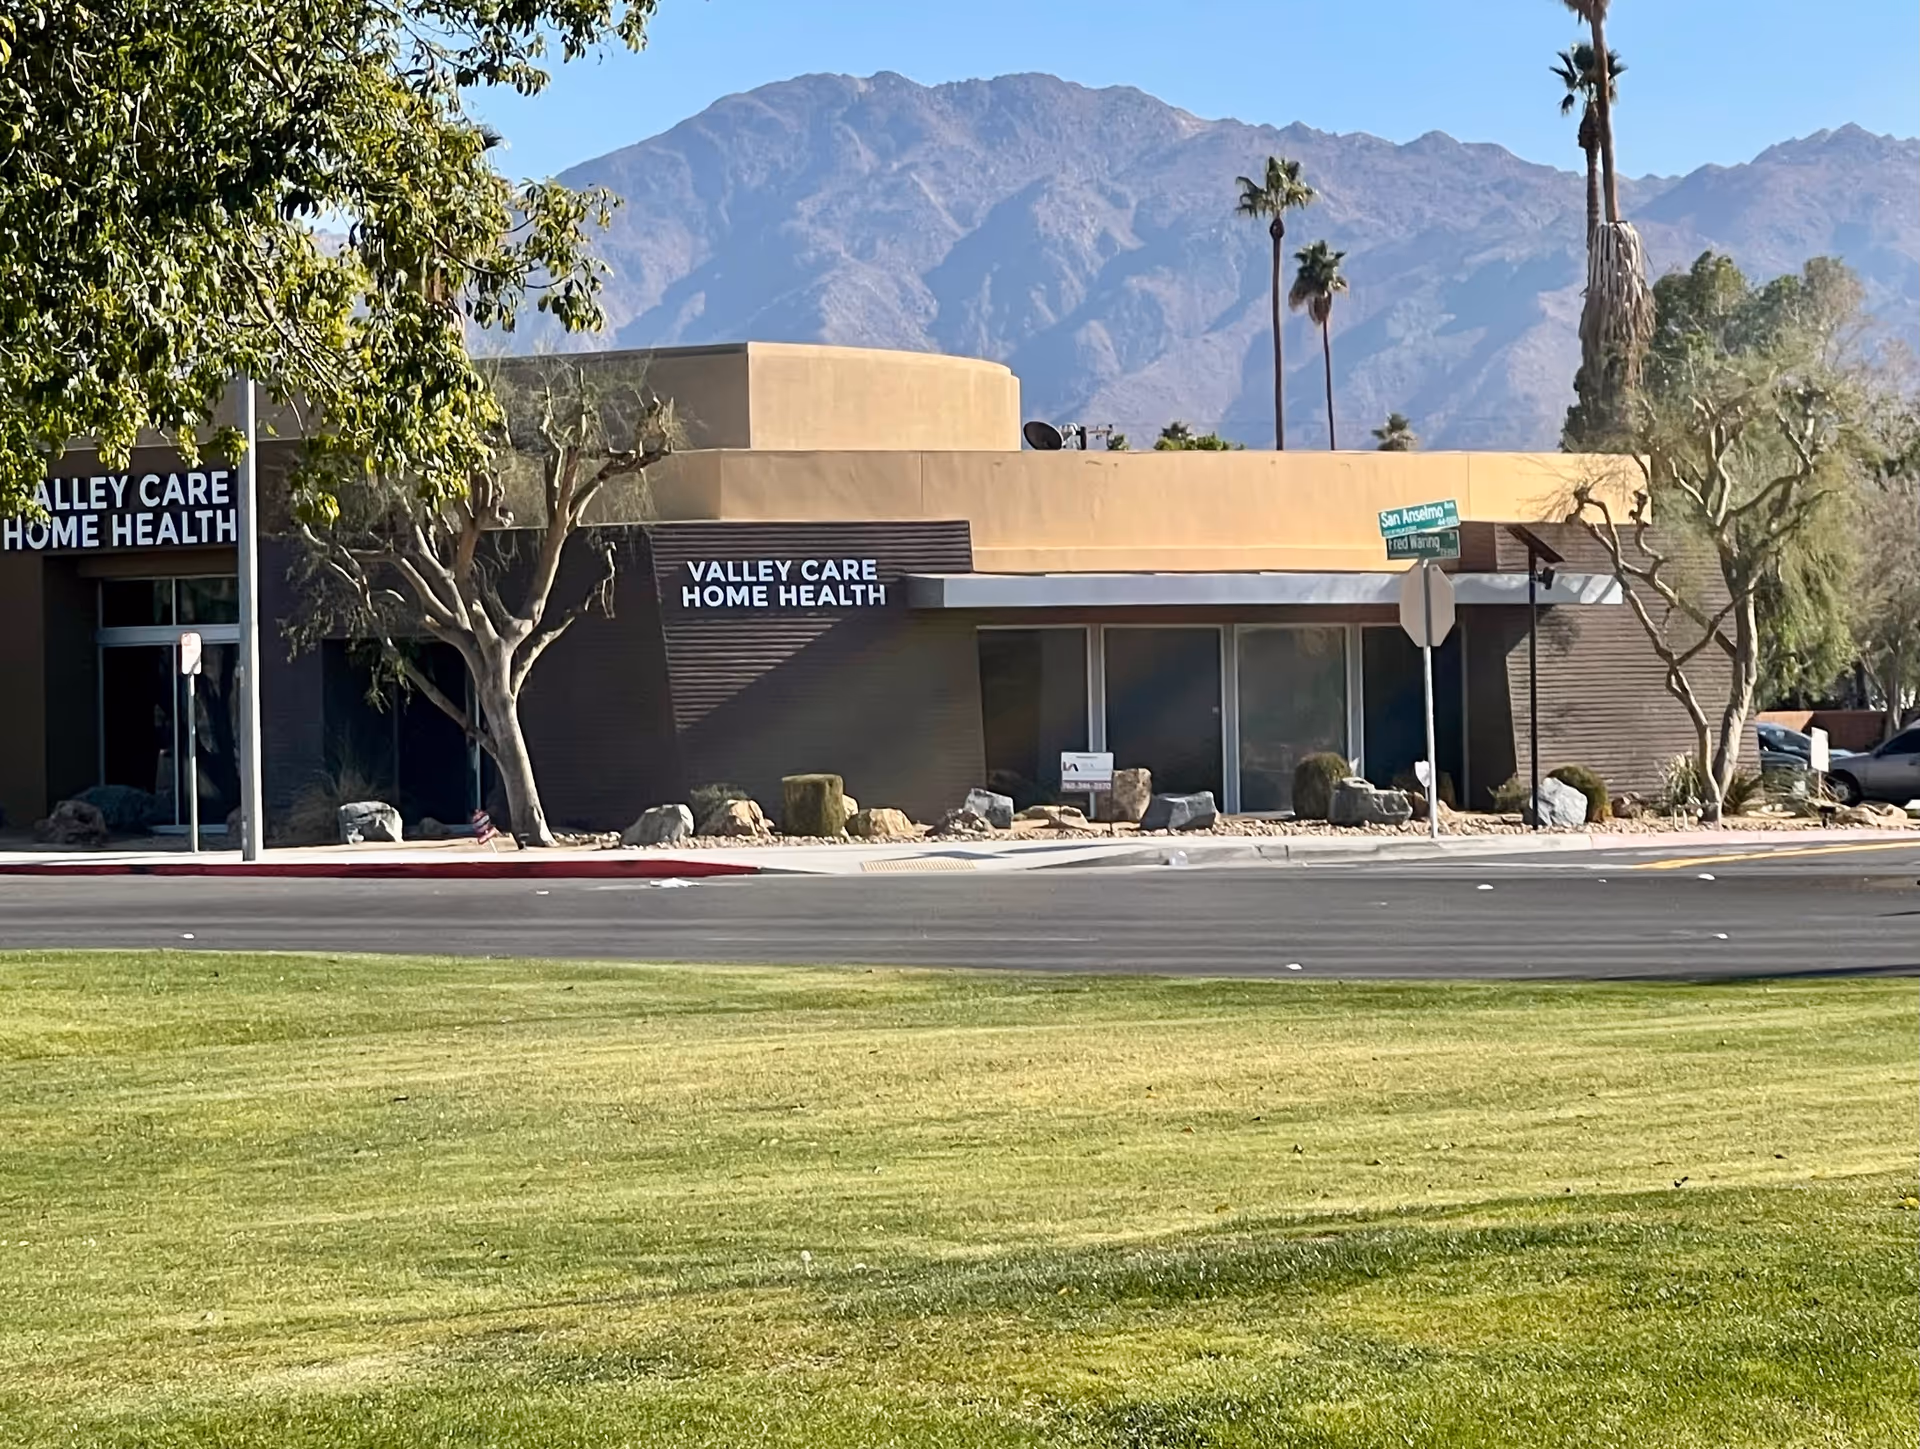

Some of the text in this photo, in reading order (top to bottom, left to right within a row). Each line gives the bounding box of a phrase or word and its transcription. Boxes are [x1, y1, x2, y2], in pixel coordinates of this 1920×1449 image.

[21, 471, 229, 511] ALLEY CARE
[1381, 512, 1401, 528] San
[1402, 505, 1443, 524] Anselmo
[4, 509, 236, 550] HOME HEALTH
[1409, 535, 1440, 552] Waring
[687, 559, 878, 582] VALLEY CARE
[682, 584, 886, 607] HOME HEALTH
